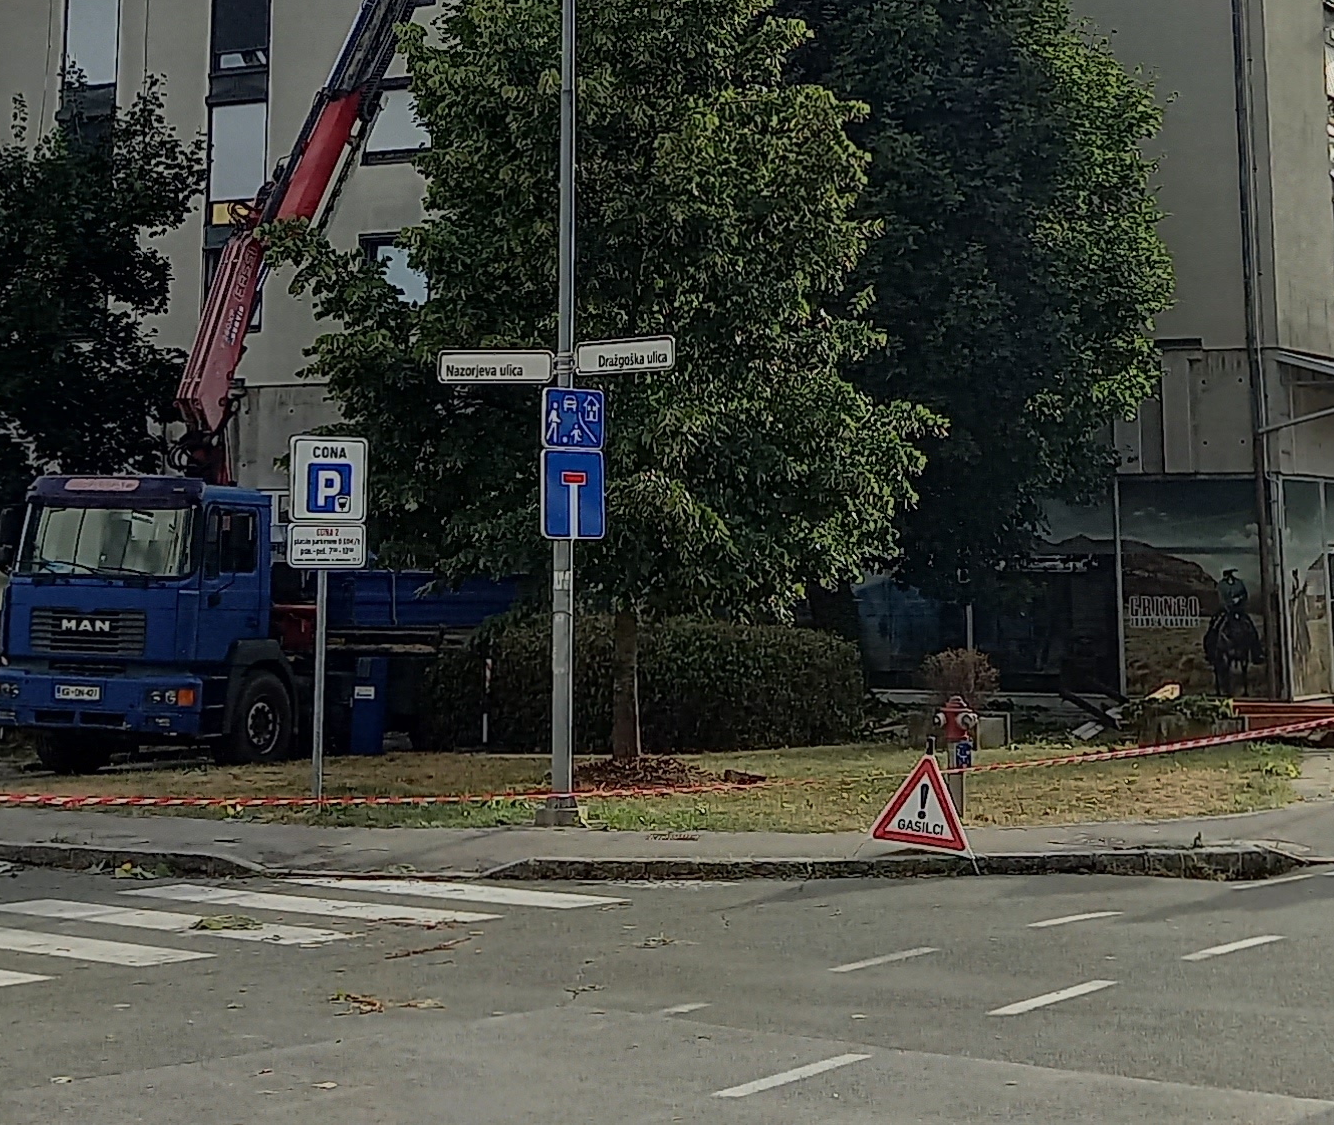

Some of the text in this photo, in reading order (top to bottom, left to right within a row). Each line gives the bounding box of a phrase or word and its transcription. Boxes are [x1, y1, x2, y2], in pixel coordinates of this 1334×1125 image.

[598, 351, 668, 368] Dražgoška ulica
[446, 363, 524, 378] Nazorjeva ulica
[312, 446, 347, 459] CONA
[317, 469, 342, 507] P
[1129, 596, 1200, 617] GRINGO
[61, 619, 110, 632] MAN
[897, 818, 944, 836] GASILCI
